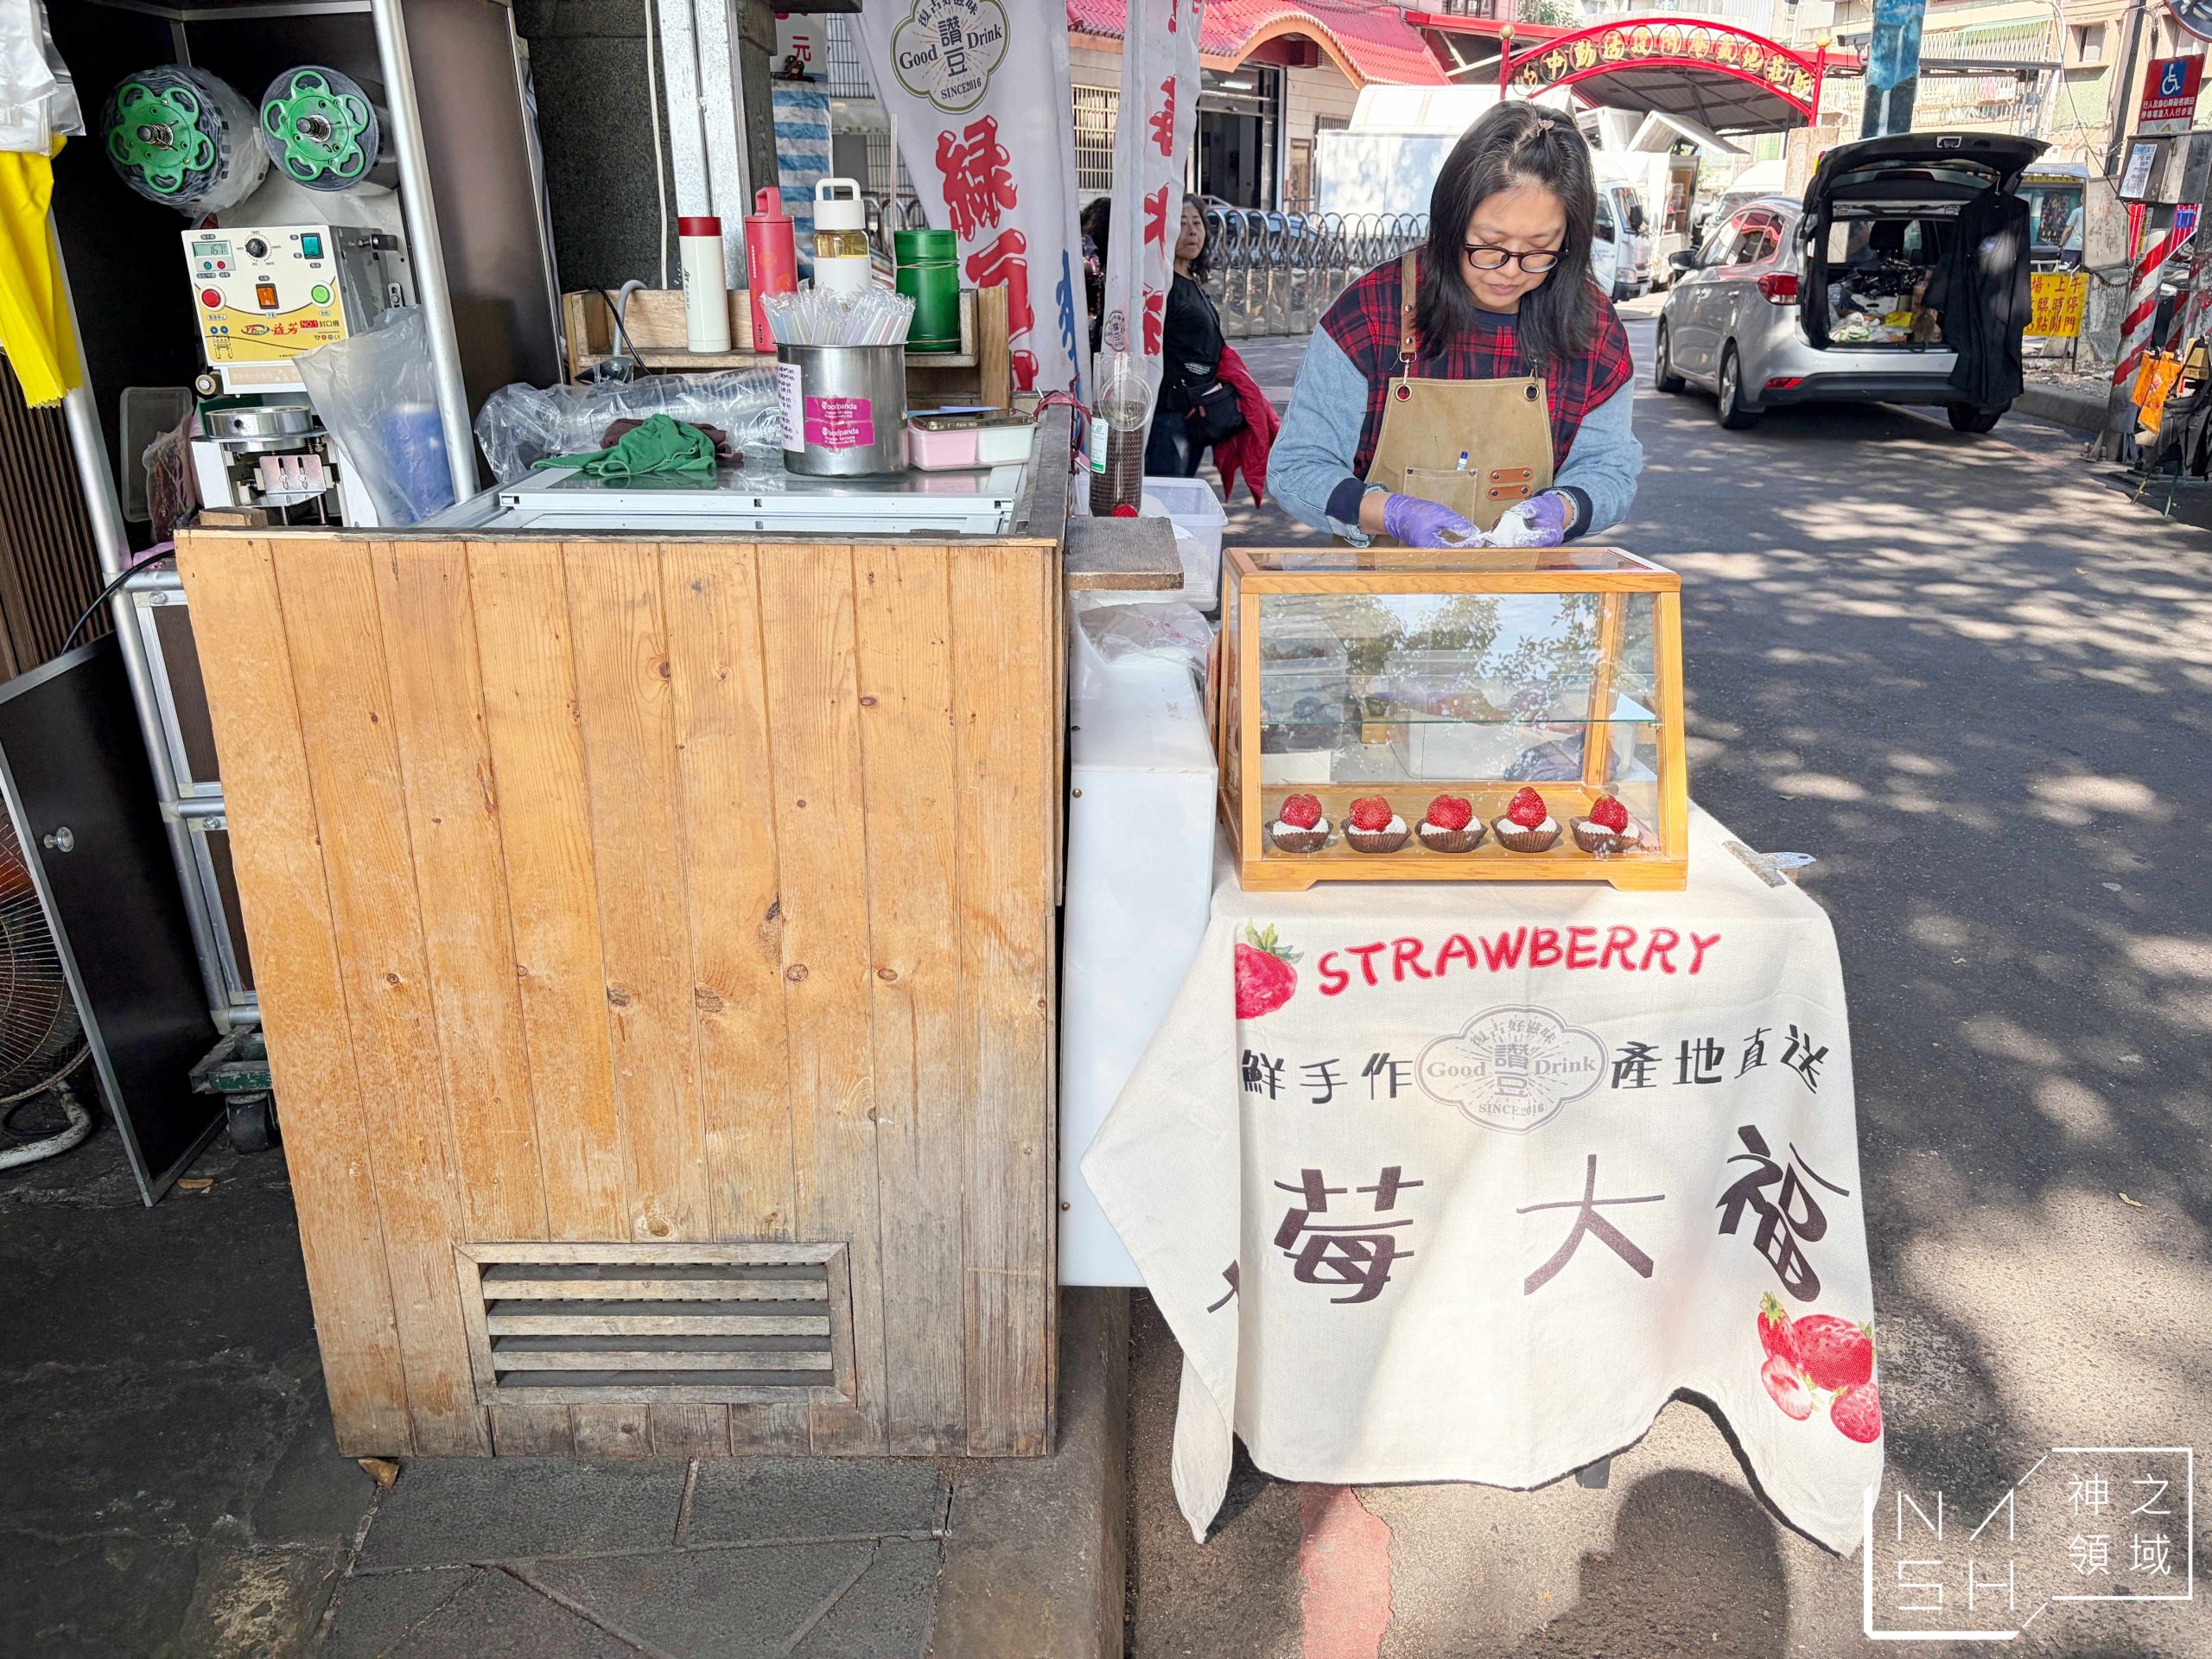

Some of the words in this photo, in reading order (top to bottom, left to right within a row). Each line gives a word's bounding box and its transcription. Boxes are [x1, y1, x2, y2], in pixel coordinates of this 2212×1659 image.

[792, 35, 811, 62] 元
[899, 44, 939, 70] Good
[966, 23, 1003, 50] Drink
[938, 15, 968, 78] 讚豆
[940, 77, 982, 100] SINCE2016
[1318, 925, 1721, 996] STRAWBERRY
[1242, 1049, 1413, 1104] 鮮手作
[1427, 1062, 1485, 1077] Good
[1535, 1056, 1597, 1076] Drink
[1494, 1043, 1529, 1097] 讚豆
[1611, 1024, 1829, 1094] 產地直送
[1478, 1103, 1545, 1116] SINCE2016
